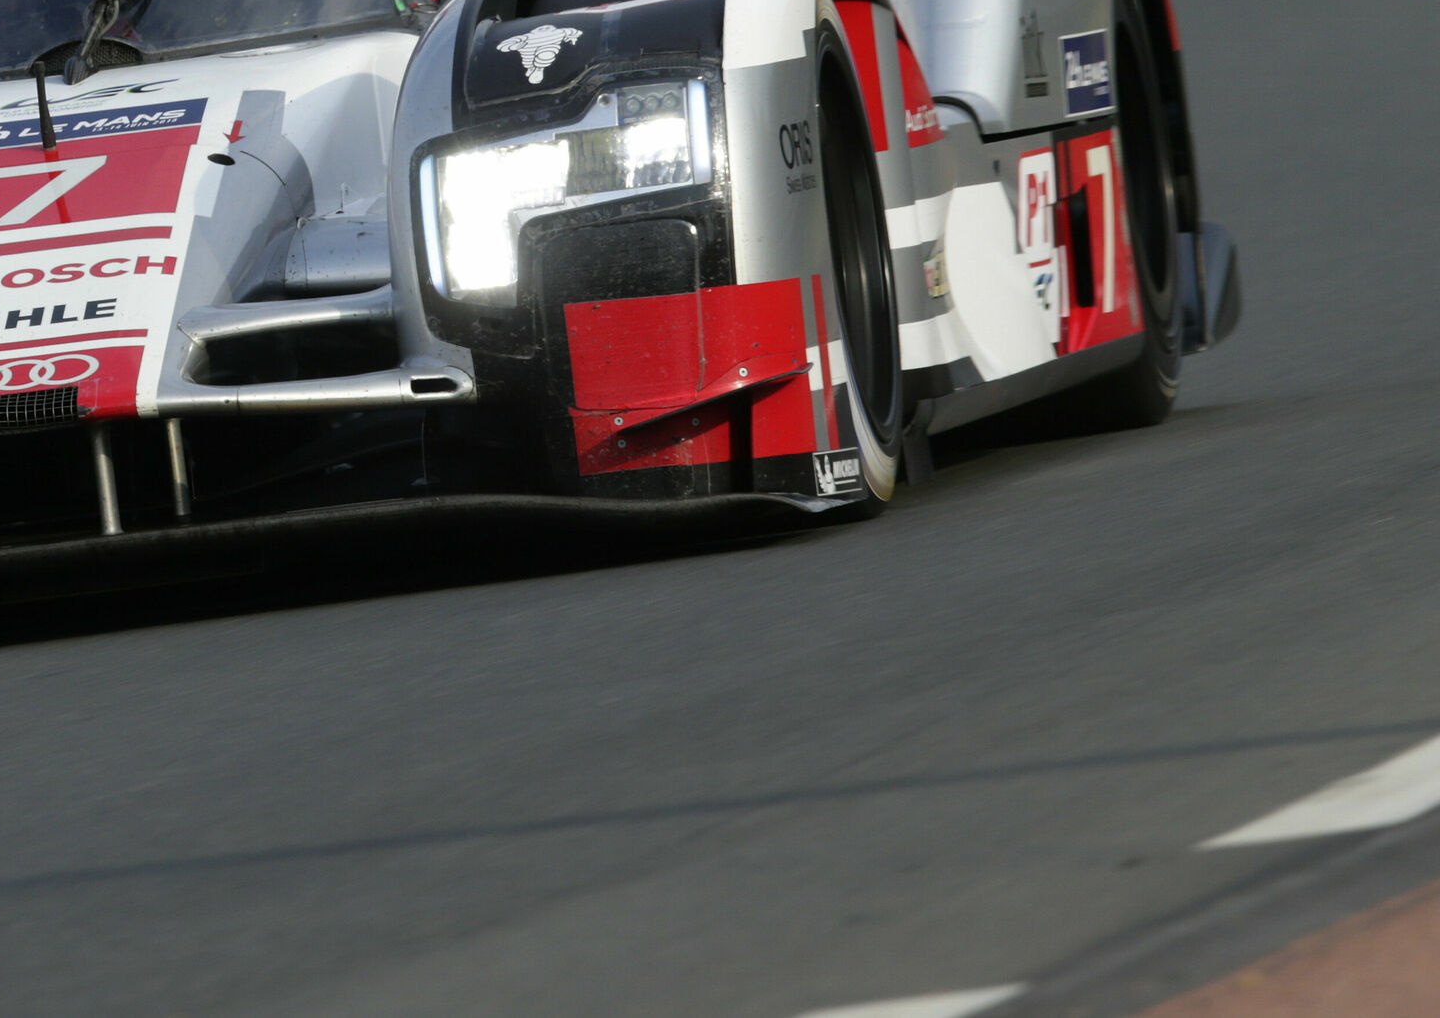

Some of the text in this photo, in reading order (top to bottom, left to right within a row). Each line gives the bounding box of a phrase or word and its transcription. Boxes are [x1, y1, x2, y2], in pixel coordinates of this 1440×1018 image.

[73, 108, 187, 132] MANS
[779, 120, 813, 169] ORIS
[1026, 170, 1050, 247] P1
